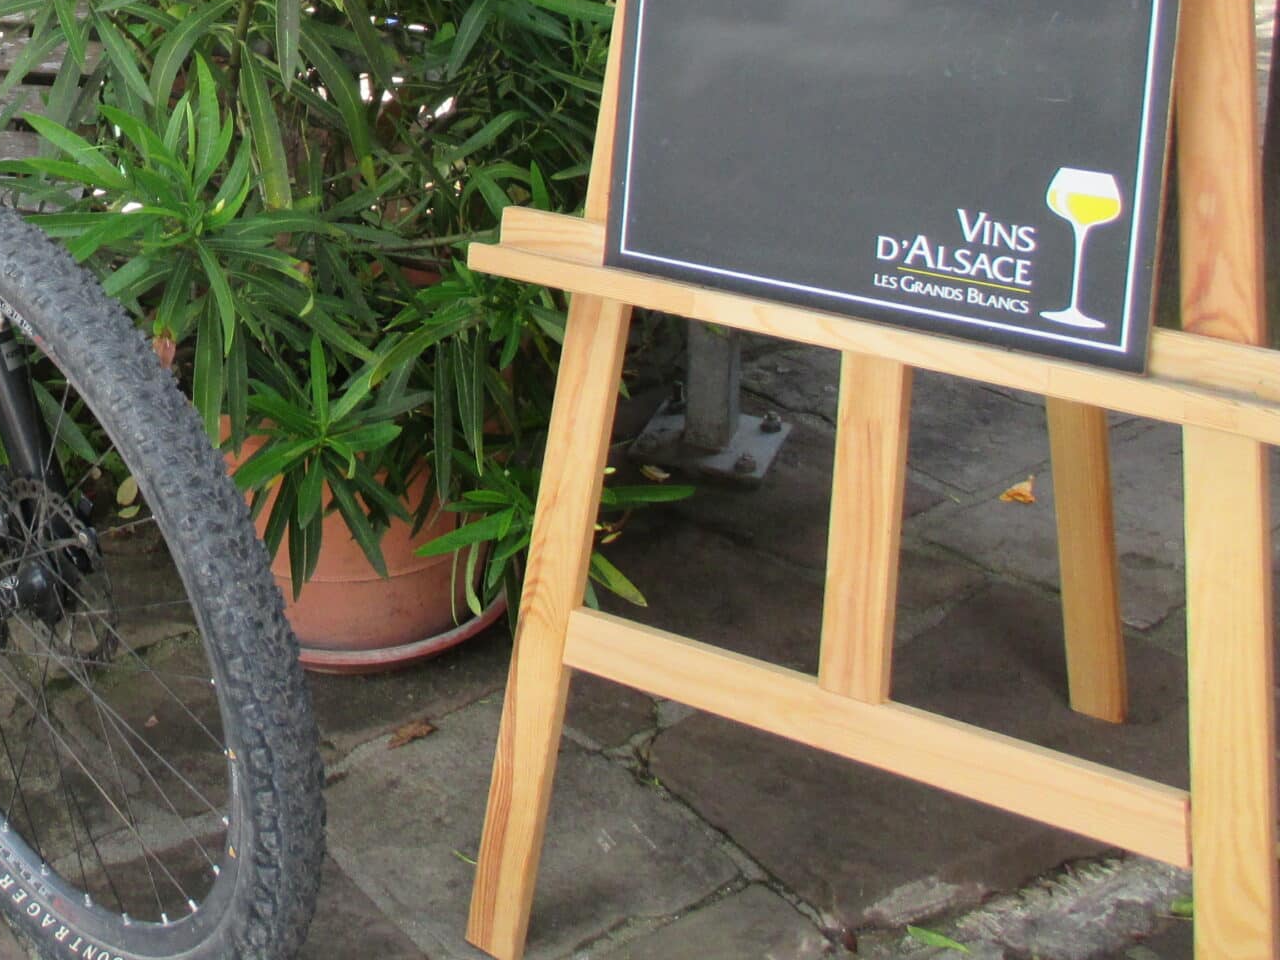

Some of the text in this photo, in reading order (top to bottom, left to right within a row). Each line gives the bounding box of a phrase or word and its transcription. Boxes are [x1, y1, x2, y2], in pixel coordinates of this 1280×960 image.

[956, 208, 1036, 253] VINS
[873, 273, 1030, 314] LES GRANDS BLANCS
